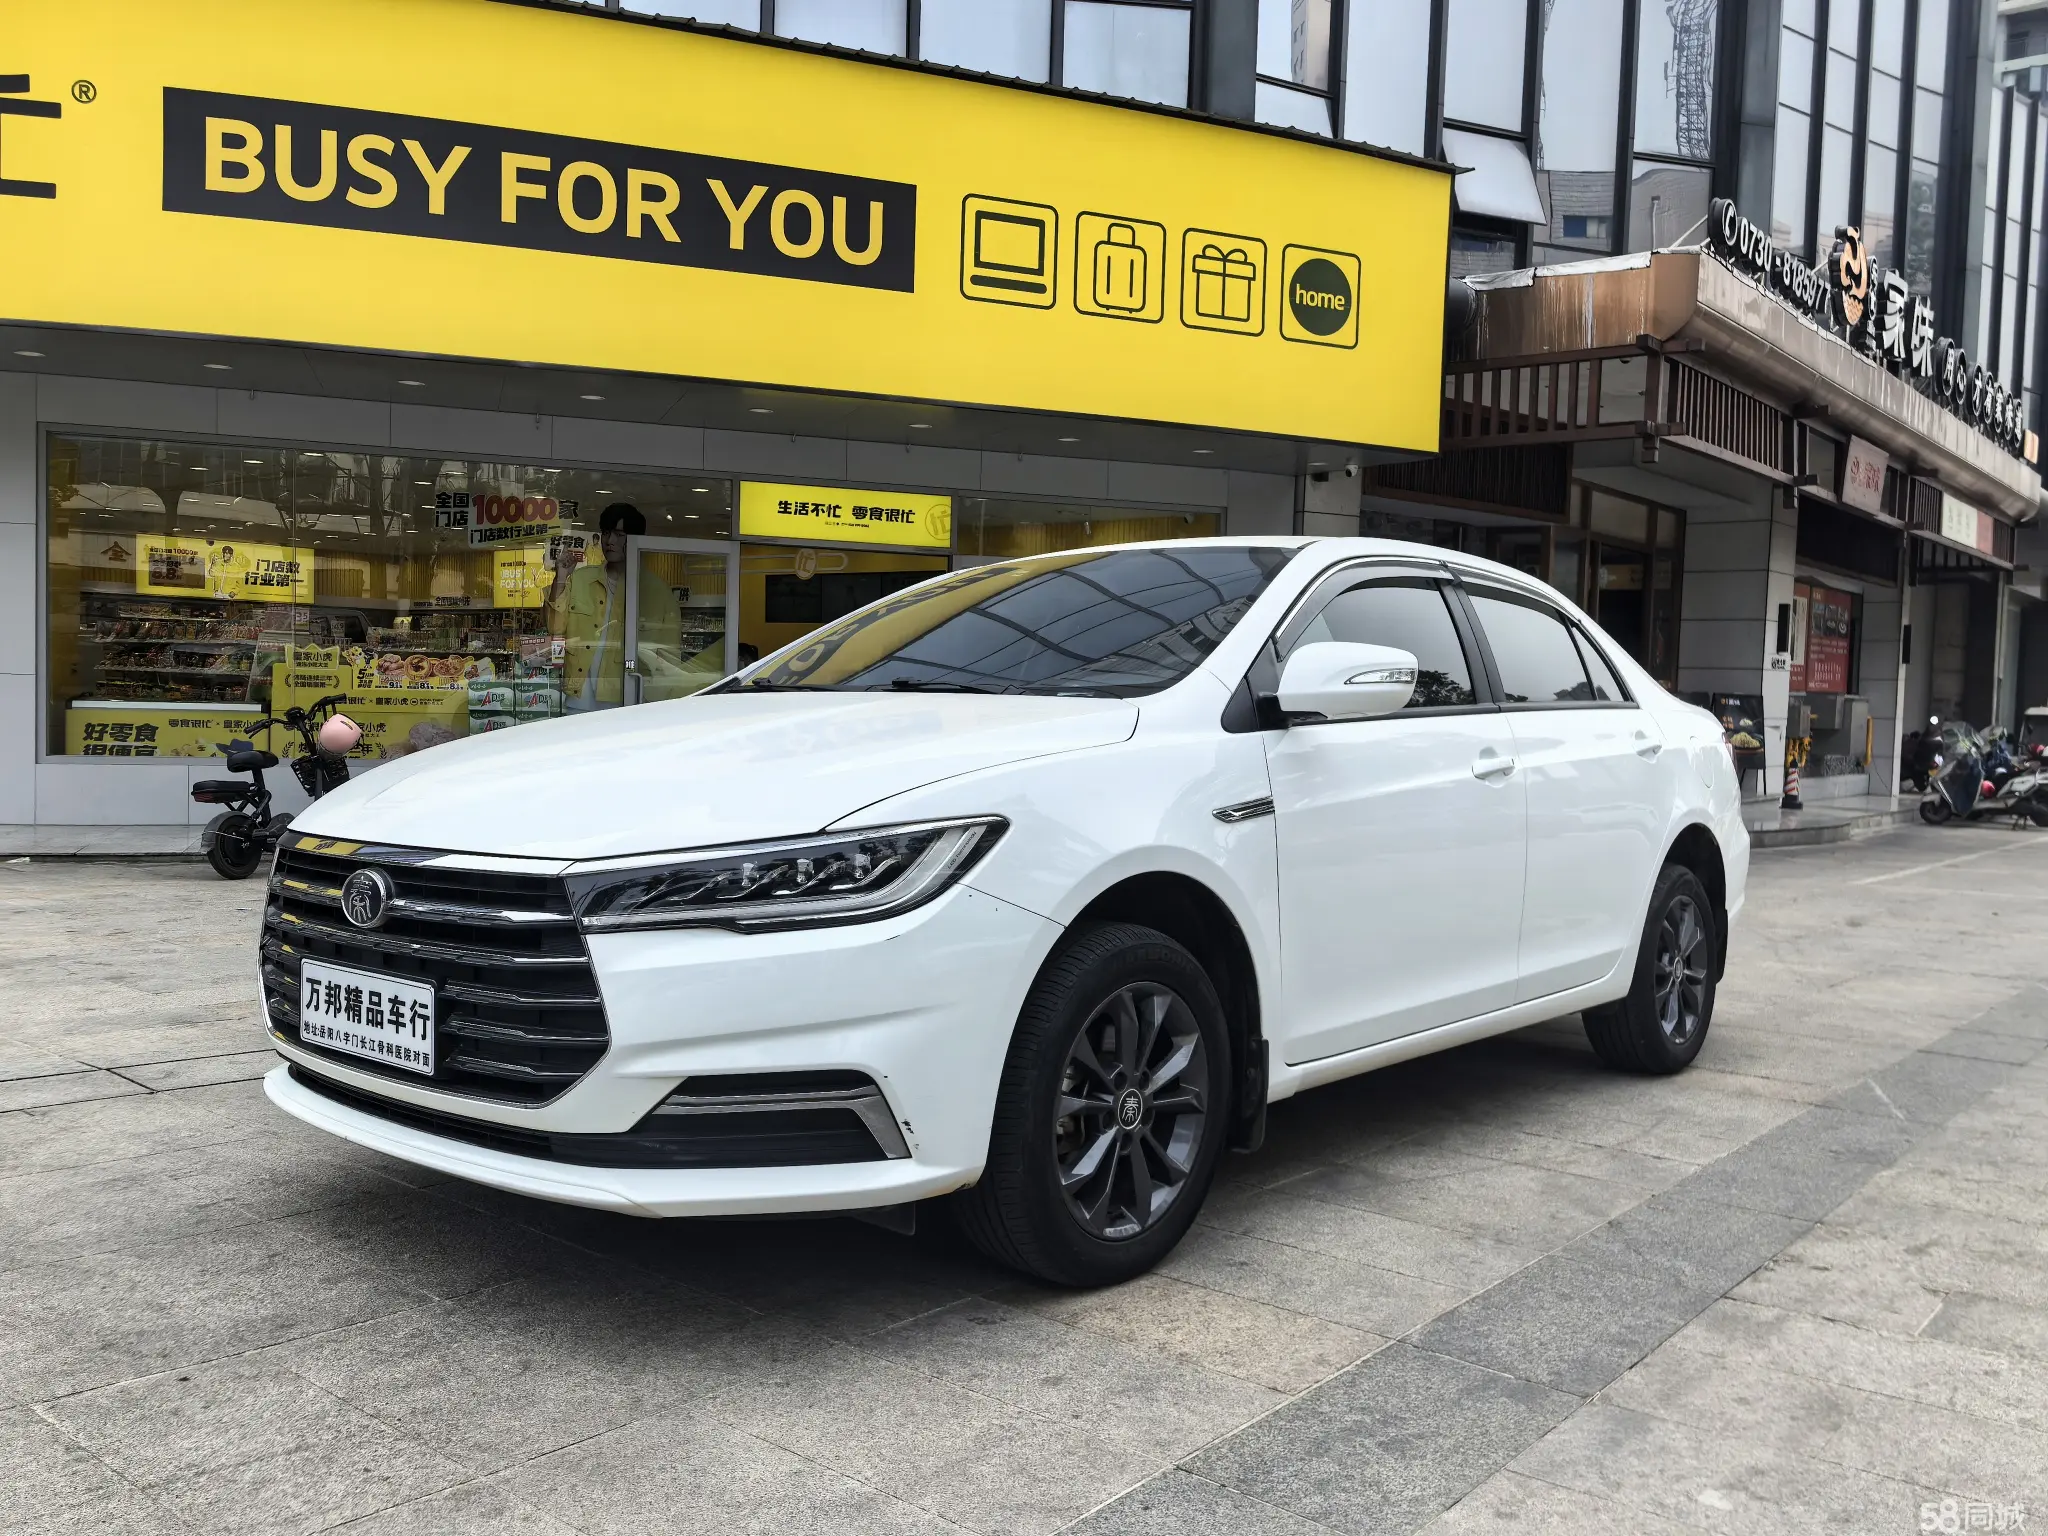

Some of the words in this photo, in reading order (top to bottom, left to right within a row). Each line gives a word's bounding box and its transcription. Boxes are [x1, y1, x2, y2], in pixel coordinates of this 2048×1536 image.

[204, 116, 472, 215] BUSY
[500, 152, 682, 243] FOR
[705, 178, 885, 267] YOU
[1295, 284, 1345, 312] home
[435, 491, 470, 509] 全国
[435, 510, 469, 528] 门店
[777, 500, 843, 519] 生活不忙
[852, 505, 916, 524] 零食很忙
[470, 523, 561, 545] 门店数行业第一
[256, 559, 300, 574] 门店数
[244, 571, 304, 588] 行业第一
[83, 722, 160, 743] 好零食
[168, 719, 213, 729] 零食很忙
[304, 977, 431, 1041] 万邦精品车行
